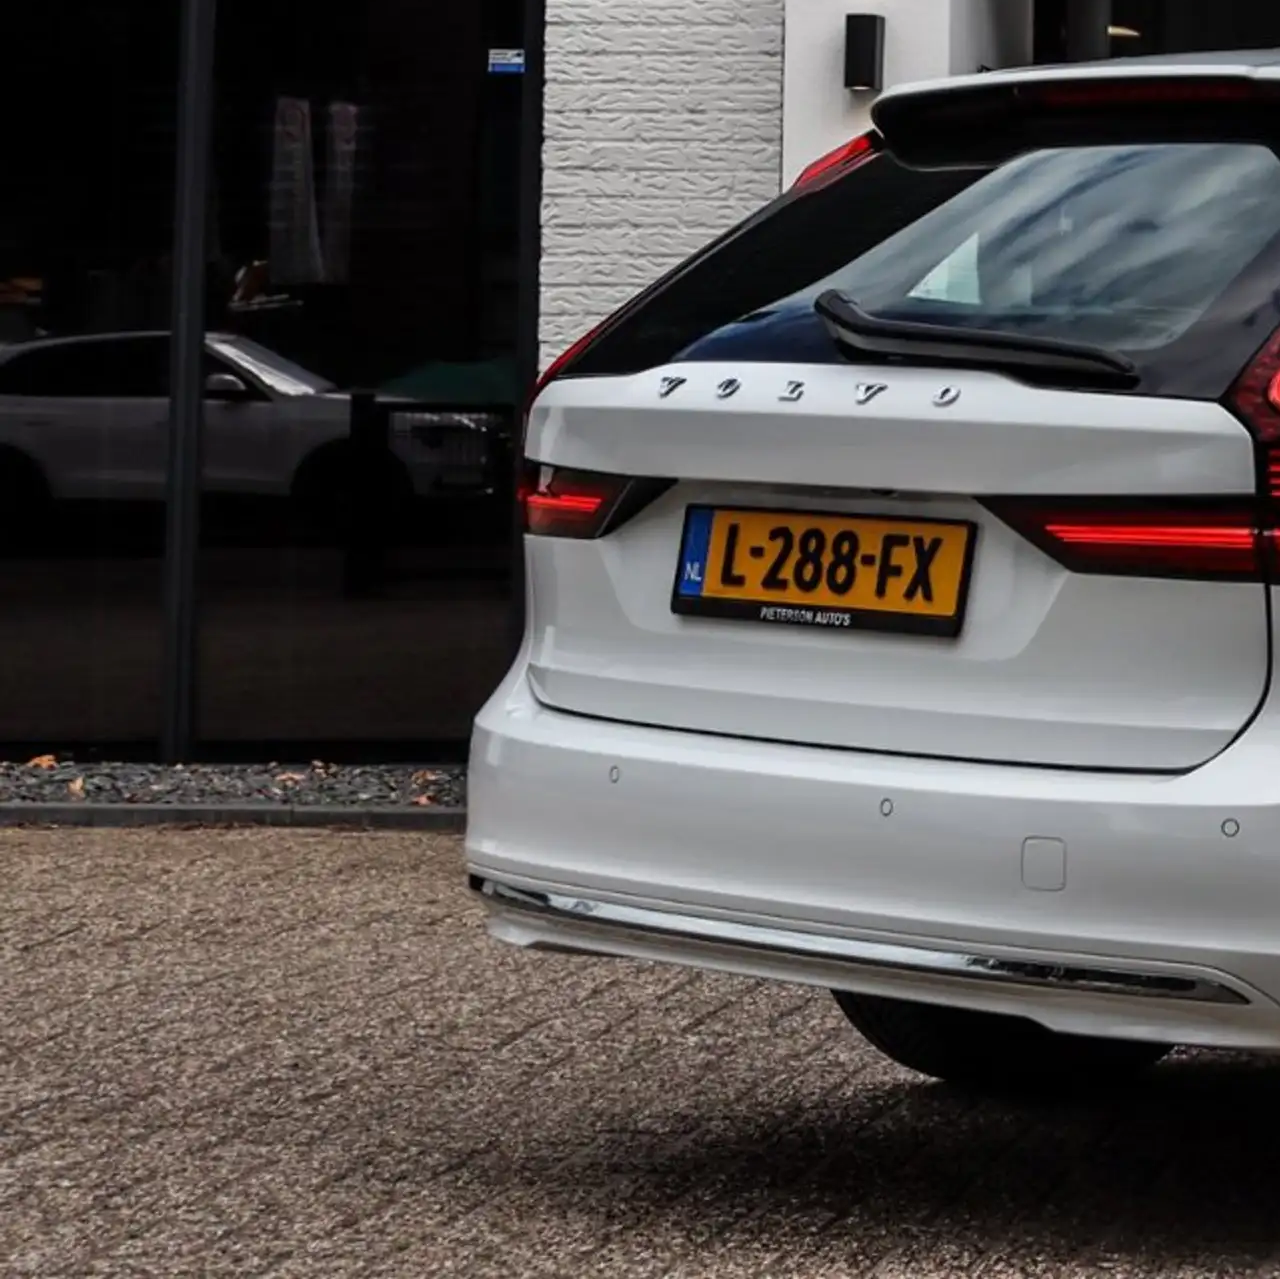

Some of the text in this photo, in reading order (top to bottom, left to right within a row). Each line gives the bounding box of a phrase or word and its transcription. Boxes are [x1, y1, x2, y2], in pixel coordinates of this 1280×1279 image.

[659, 375, 961, 408] VOLVO
[684, 561, 702, 581] NL
[719, 522, 944, 603] L-288-FX
[760, 605, 813, 623] PIETERSON
